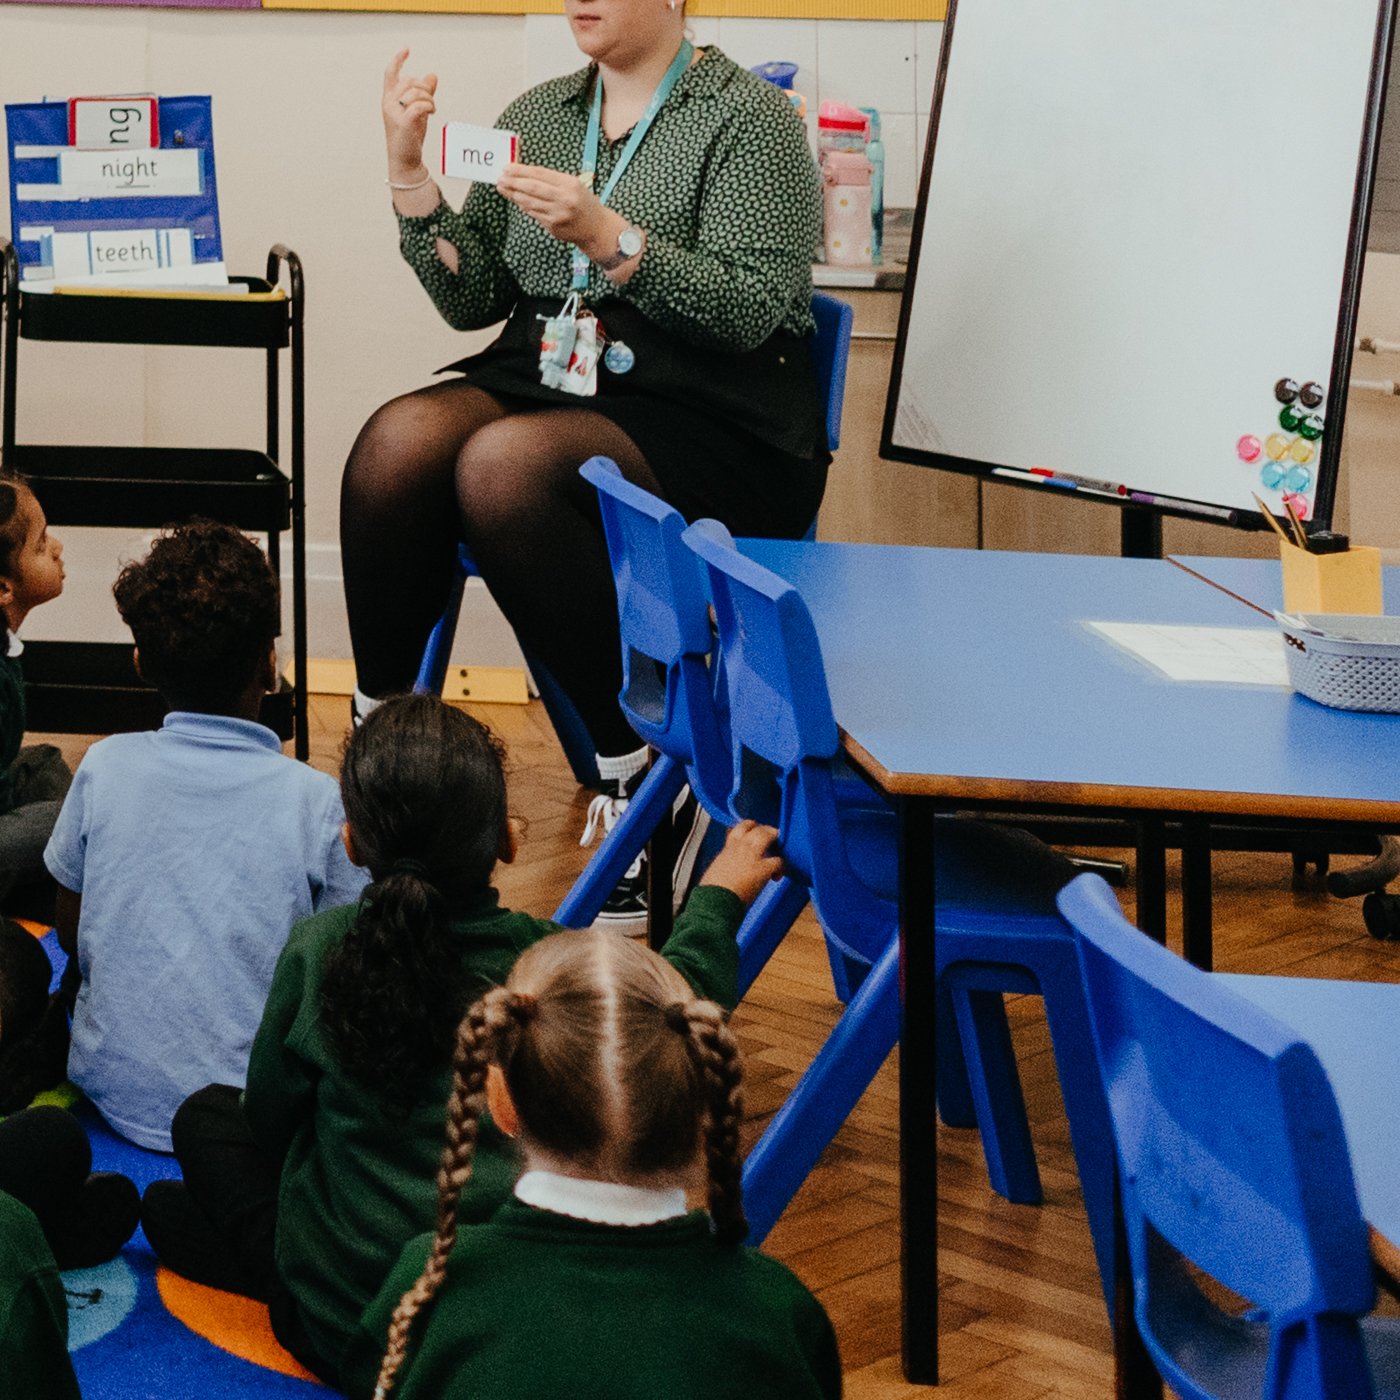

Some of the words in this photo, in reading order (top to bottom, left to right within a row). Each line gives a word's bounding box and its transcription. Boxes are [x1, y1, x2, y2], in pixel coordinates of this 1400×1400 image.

[109, 107, 141, 145] ng
[462, 147, 494, 167] me
[102, 157, 158, 186] night
[96, 240, 154, 262] teeth
